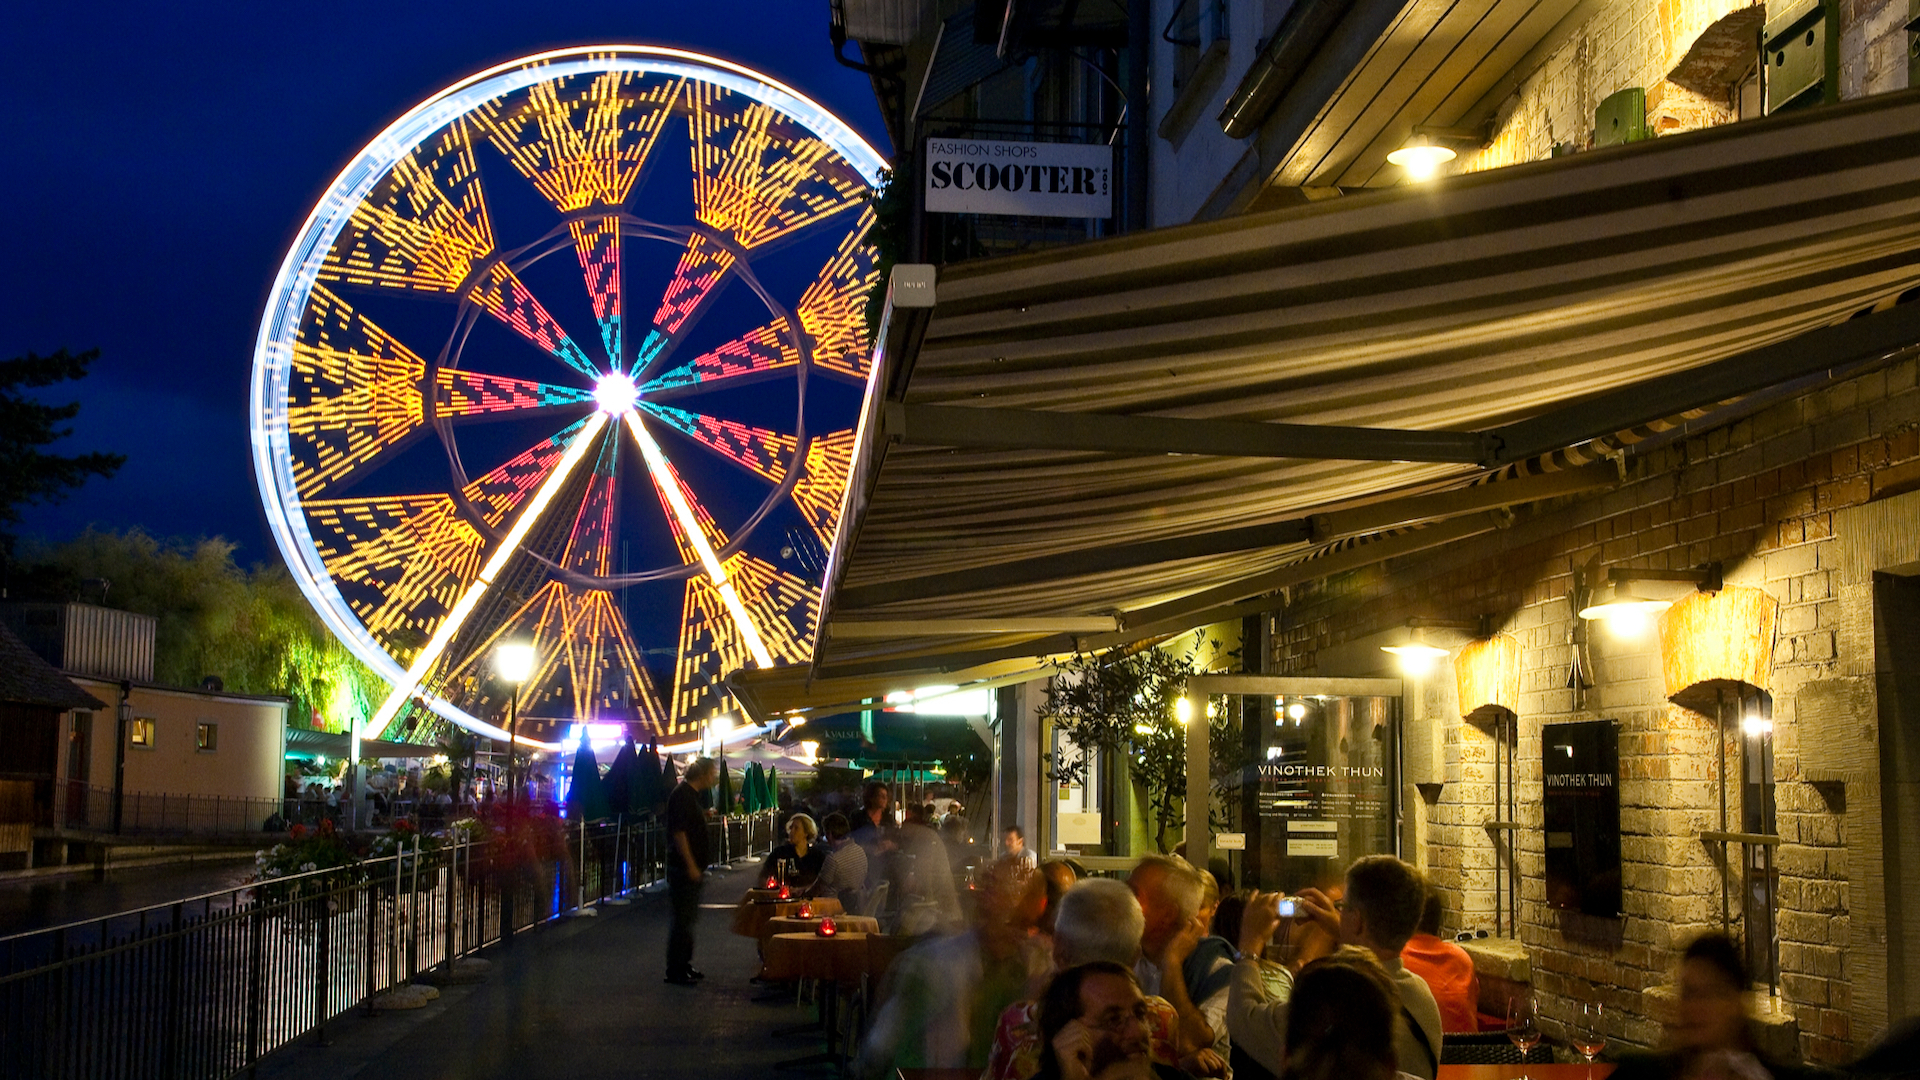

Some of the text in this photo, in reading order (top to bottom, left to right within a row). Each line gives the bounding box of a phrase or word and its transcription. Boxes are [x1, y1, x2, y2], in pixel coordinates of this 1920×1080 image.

[931, 142, 1037, 158] FASHION SHOPS
[931, 160, 1097, 195] SCOOTER
[1258, 765, 1384, 777] VINOTHEK THUN
[1547, 773, 1612, 787] VINOTHEK THUN
